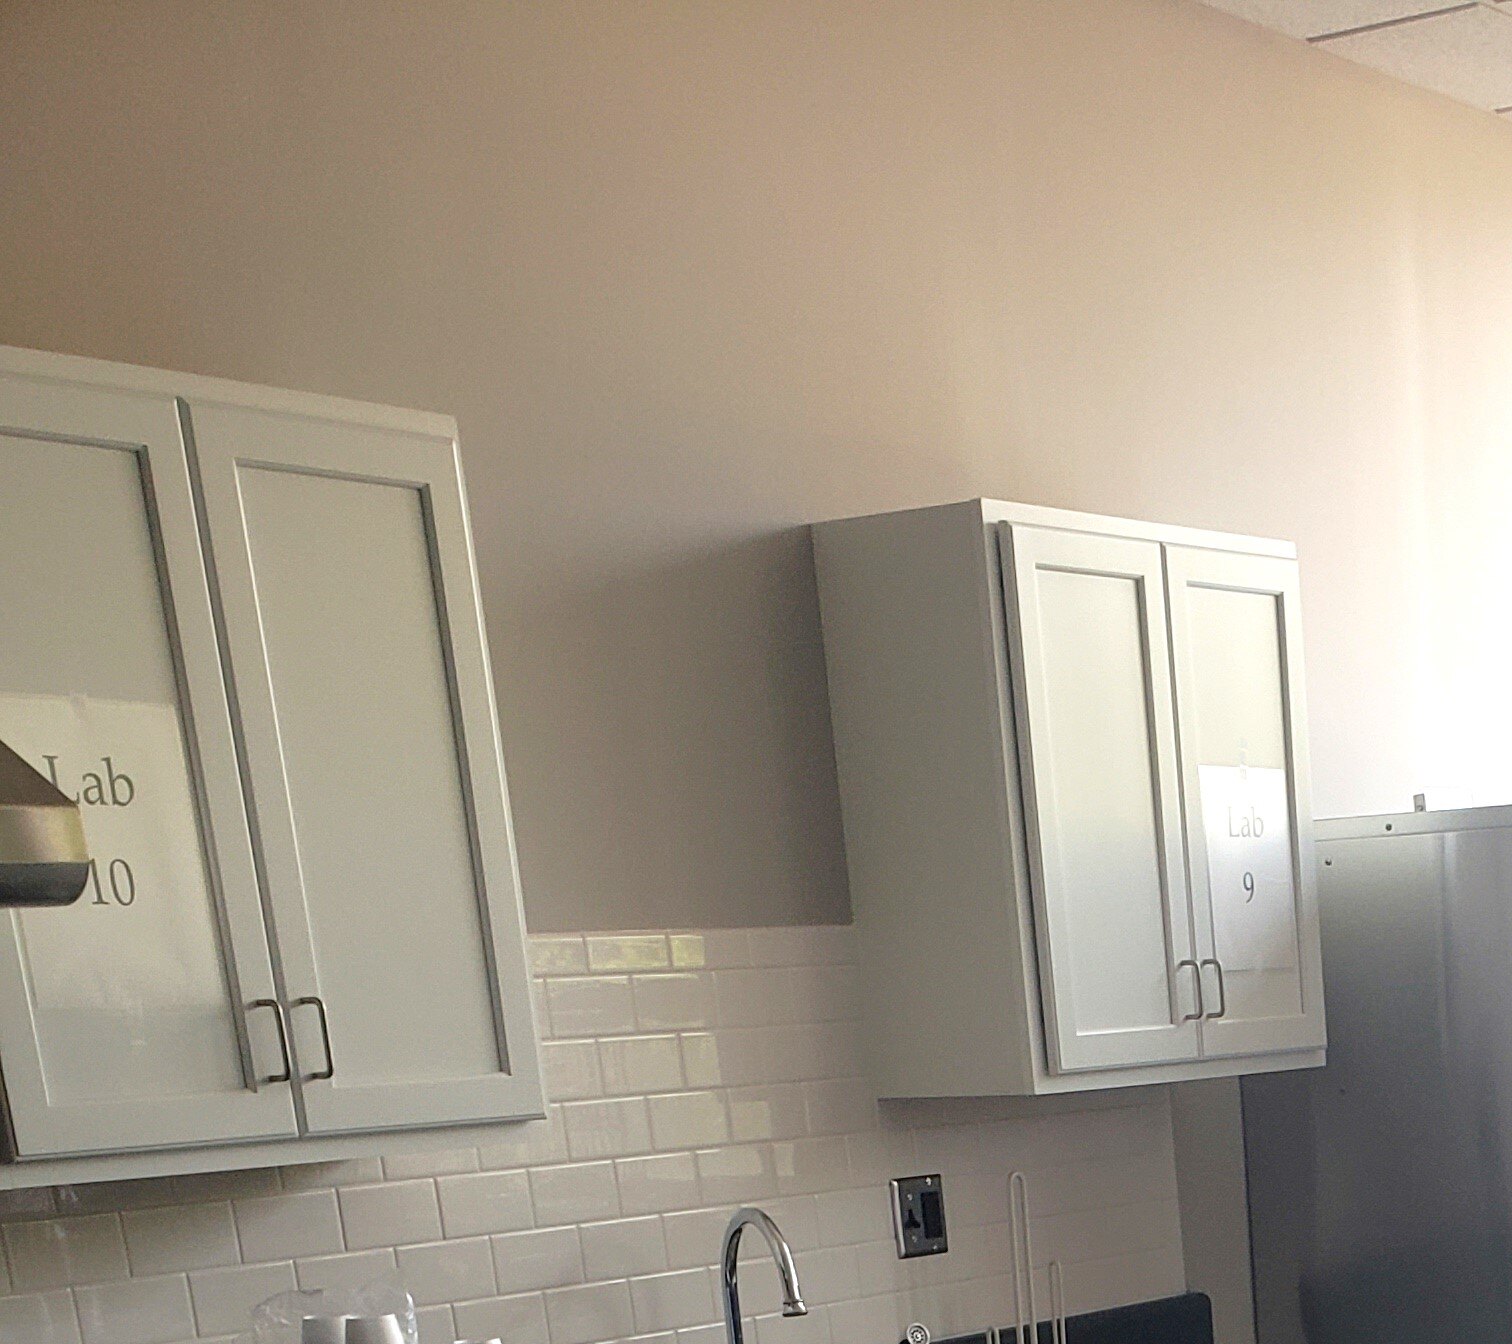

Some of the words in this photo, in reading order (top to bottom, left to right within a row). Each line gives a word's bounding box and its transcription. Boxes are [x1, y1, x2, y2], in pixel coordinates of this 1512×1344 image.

[1228, 806, 1264, 838] Lab
[89, 858, 135, 906] 10
[1243, 872, 1255, 904] 9
